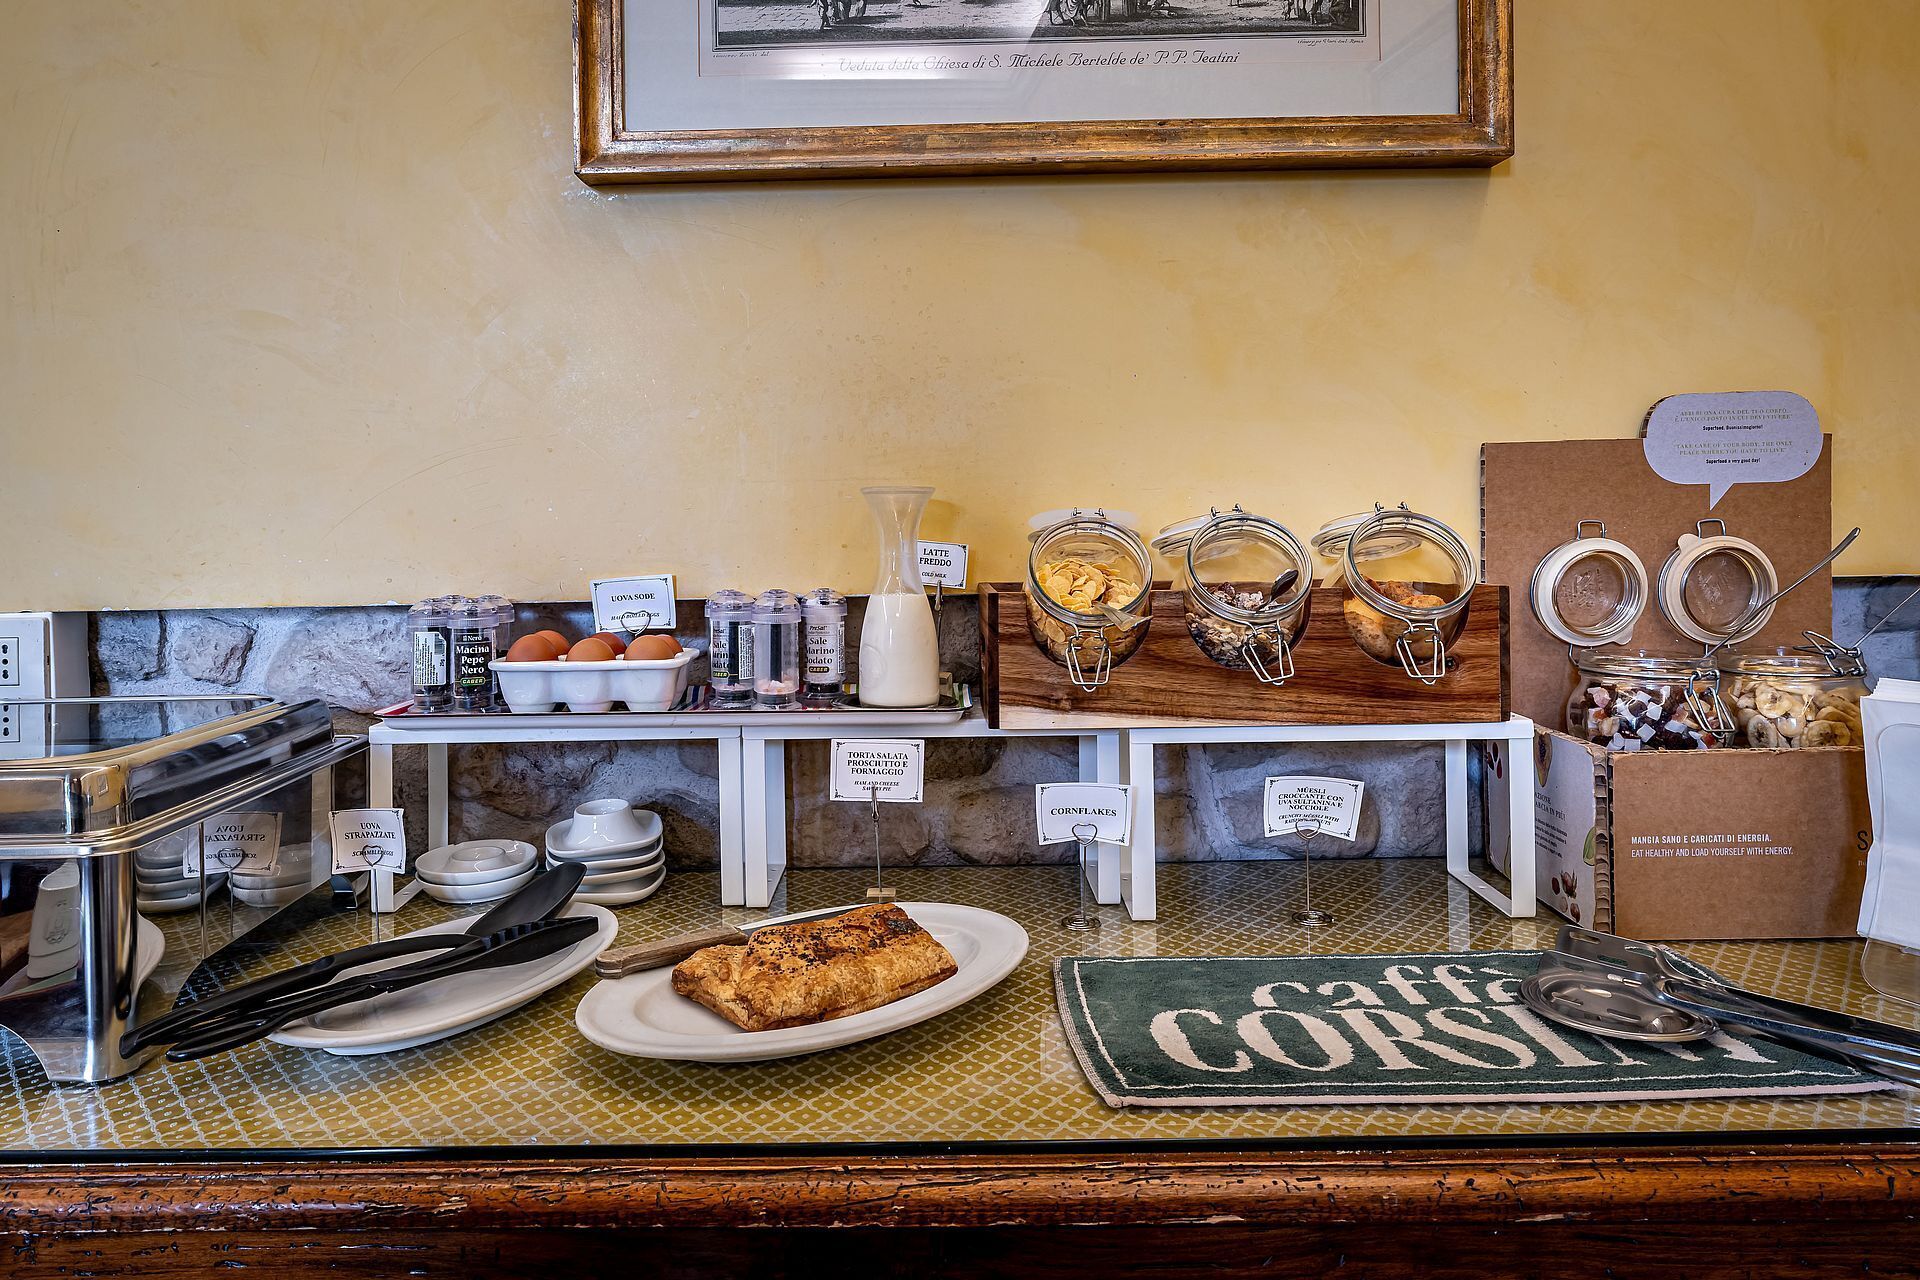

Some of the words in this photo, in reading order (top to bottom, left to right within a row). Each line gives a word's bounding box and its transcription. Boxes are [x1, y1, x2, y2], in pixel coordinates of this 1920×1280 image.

[840, 57, 885, 71] Veduta
[888, 56, 919, 70] della
[923, 55, 969, 69] Chiesa
[972, 55, 987, 68] di
[988, 53, 1002, 68] S.
[1007, 52, 1064, 68] Michele
[1066, 51, 1127, 66] Bertelde
[1191, 49, 1241, 64] Teatini
[923, 548, 950, 557] LATTE
[919, 557, 952, 567] FREDDO
[611, 594, 634, 602] UOVA
[809, 637, 828, 645] Sale
[456, 645, 490, 654] Macina
[461, 655, 485, 665] Pepe
[461, 666, 485, 675] Nero
[847, 751, 876, 759] TORTA
[876, 752, 908, 760] SALATA
[847, 759, 901, 767] PROSCIUTTO
[902, 760, 908, 768] E
[851, 767, 904, 776] FORMAGGIO
[1293, 799, 1336, 807] SULTANINA
[1050, 807, 1117, 817] CORNFLAKES
[1288, 804, 1329, 812] NOCCIOLE
[360, 822, 381, 830] UOVA
[344, 831, 396, 840] STRAPAZZATE
[1631, 836, 1660, 845] MANGIA
[1661, 835, 1681, 844] SANO
[1683, 835, 1688, 844] E
[1690, 835, 1725, 844] CARICATI
[1727, 834, 1735, 843] DI
[1737, 834, 1772, 843] ENERGIA.
[1631, 849, 1643, 858] EAT
[1645, 849, 1674, 857] HEALTHY
[1675, 848, 1690, 857] AND
[1691, 848, 1709, 857] LOAD
[1710, 847, 1745, 856] YOURSELF
[1746, 847, 1763, 855] WITH
[1765, 846, 1793, 855] ENERGY.
[1149, 1002, 1778, 1073] CORSI
